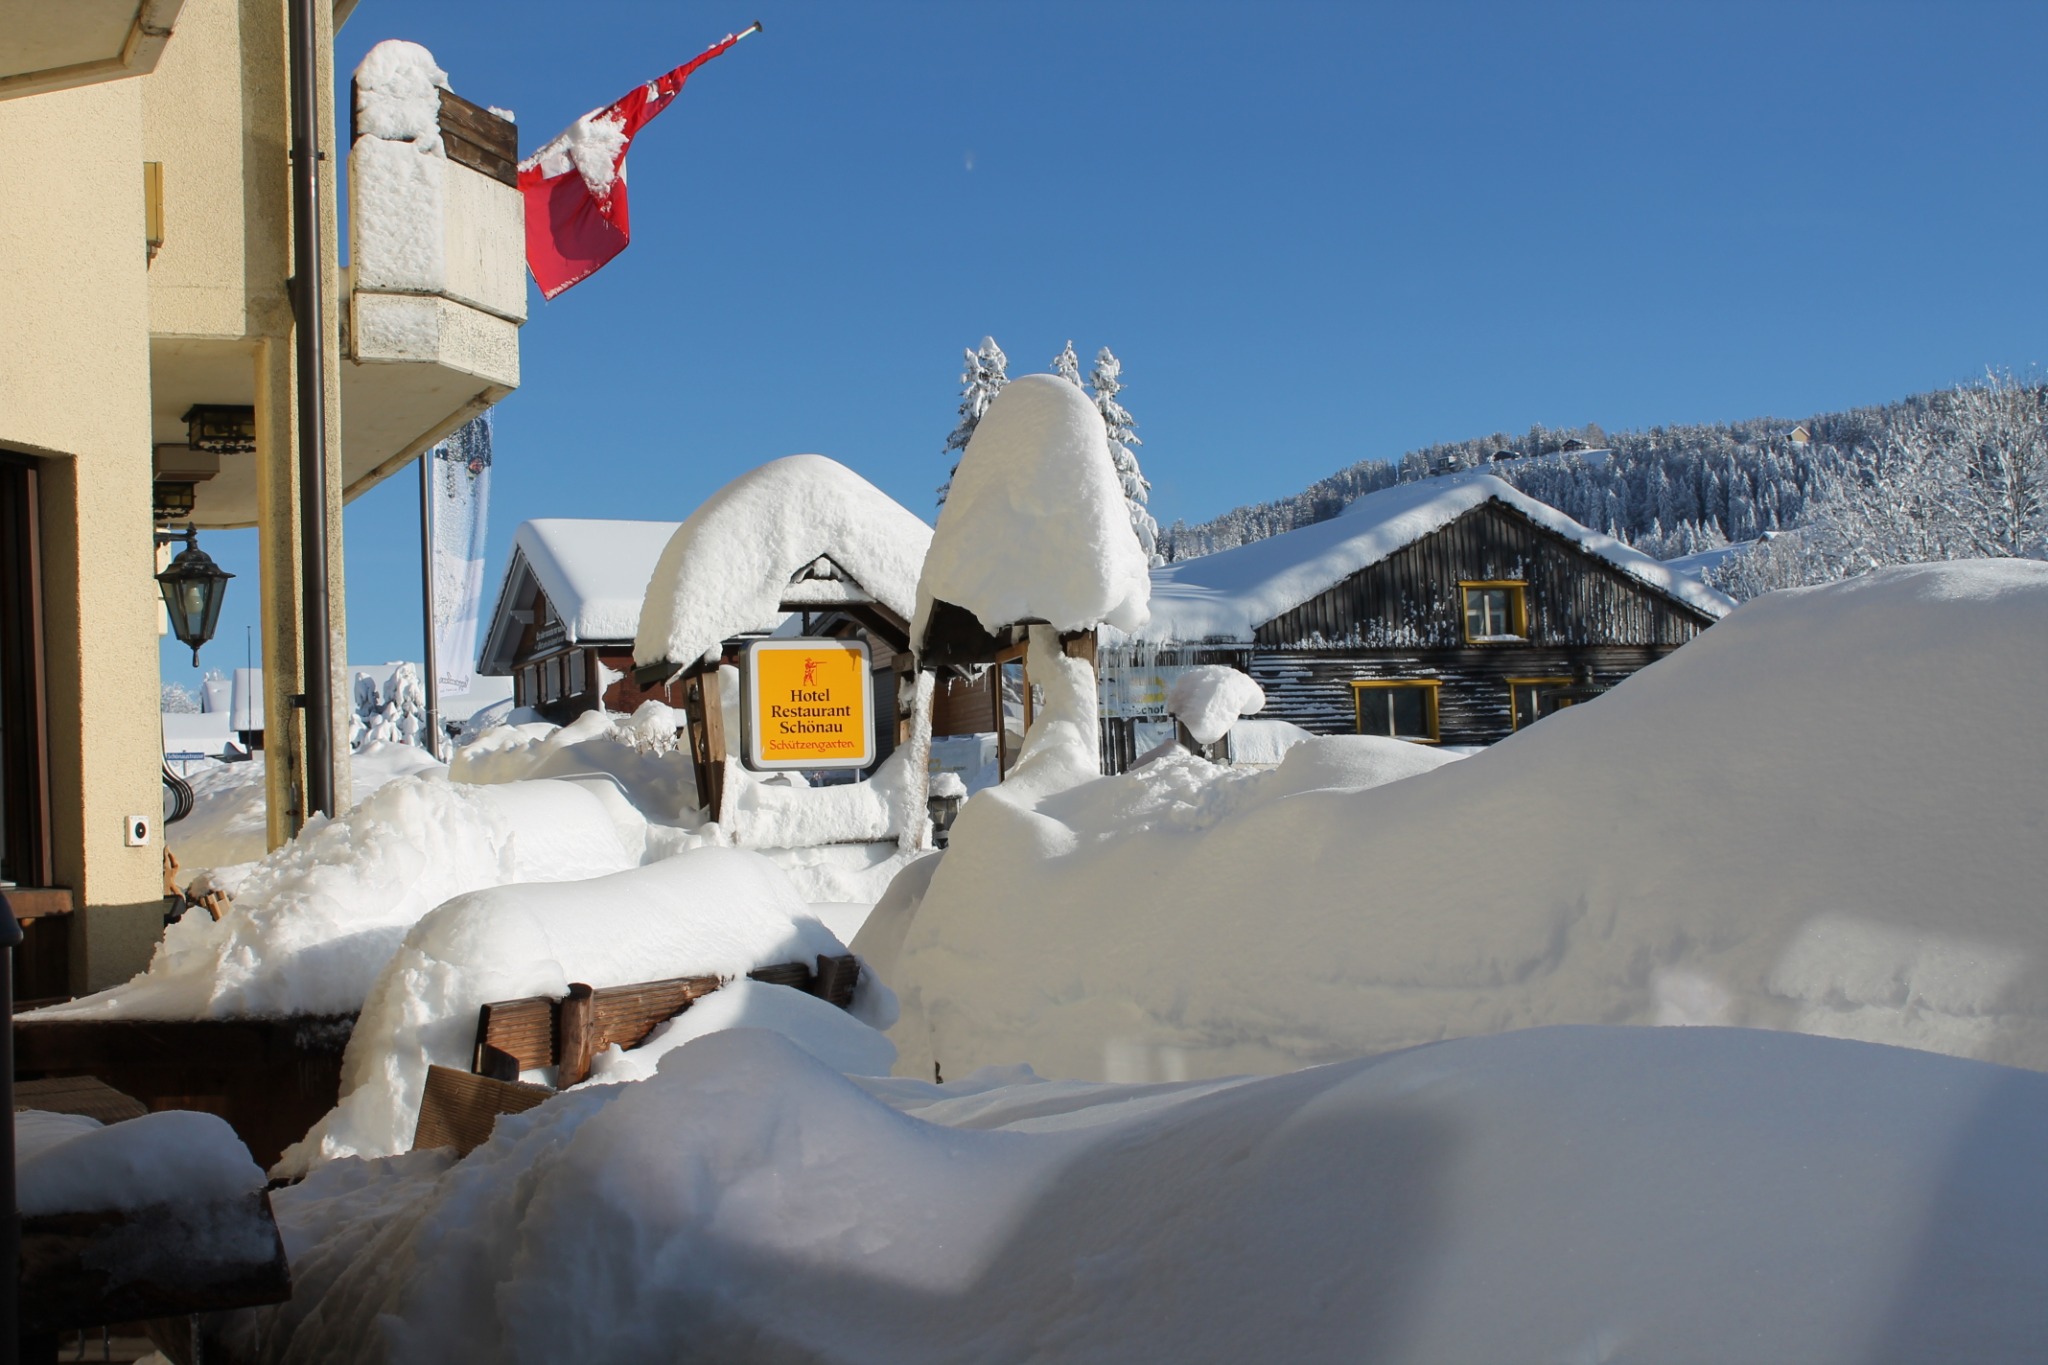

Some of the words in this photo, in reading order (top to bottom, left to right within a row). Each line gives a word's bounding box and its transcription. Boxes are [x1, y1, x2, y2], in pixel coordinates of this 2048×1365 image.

[790, 688, 830, 702] Hotel
[771, 705, 851, 718] Restaurant
[780, 720, 843, 734] Schönau
[769, 739, 855, 753] Schützengarten
